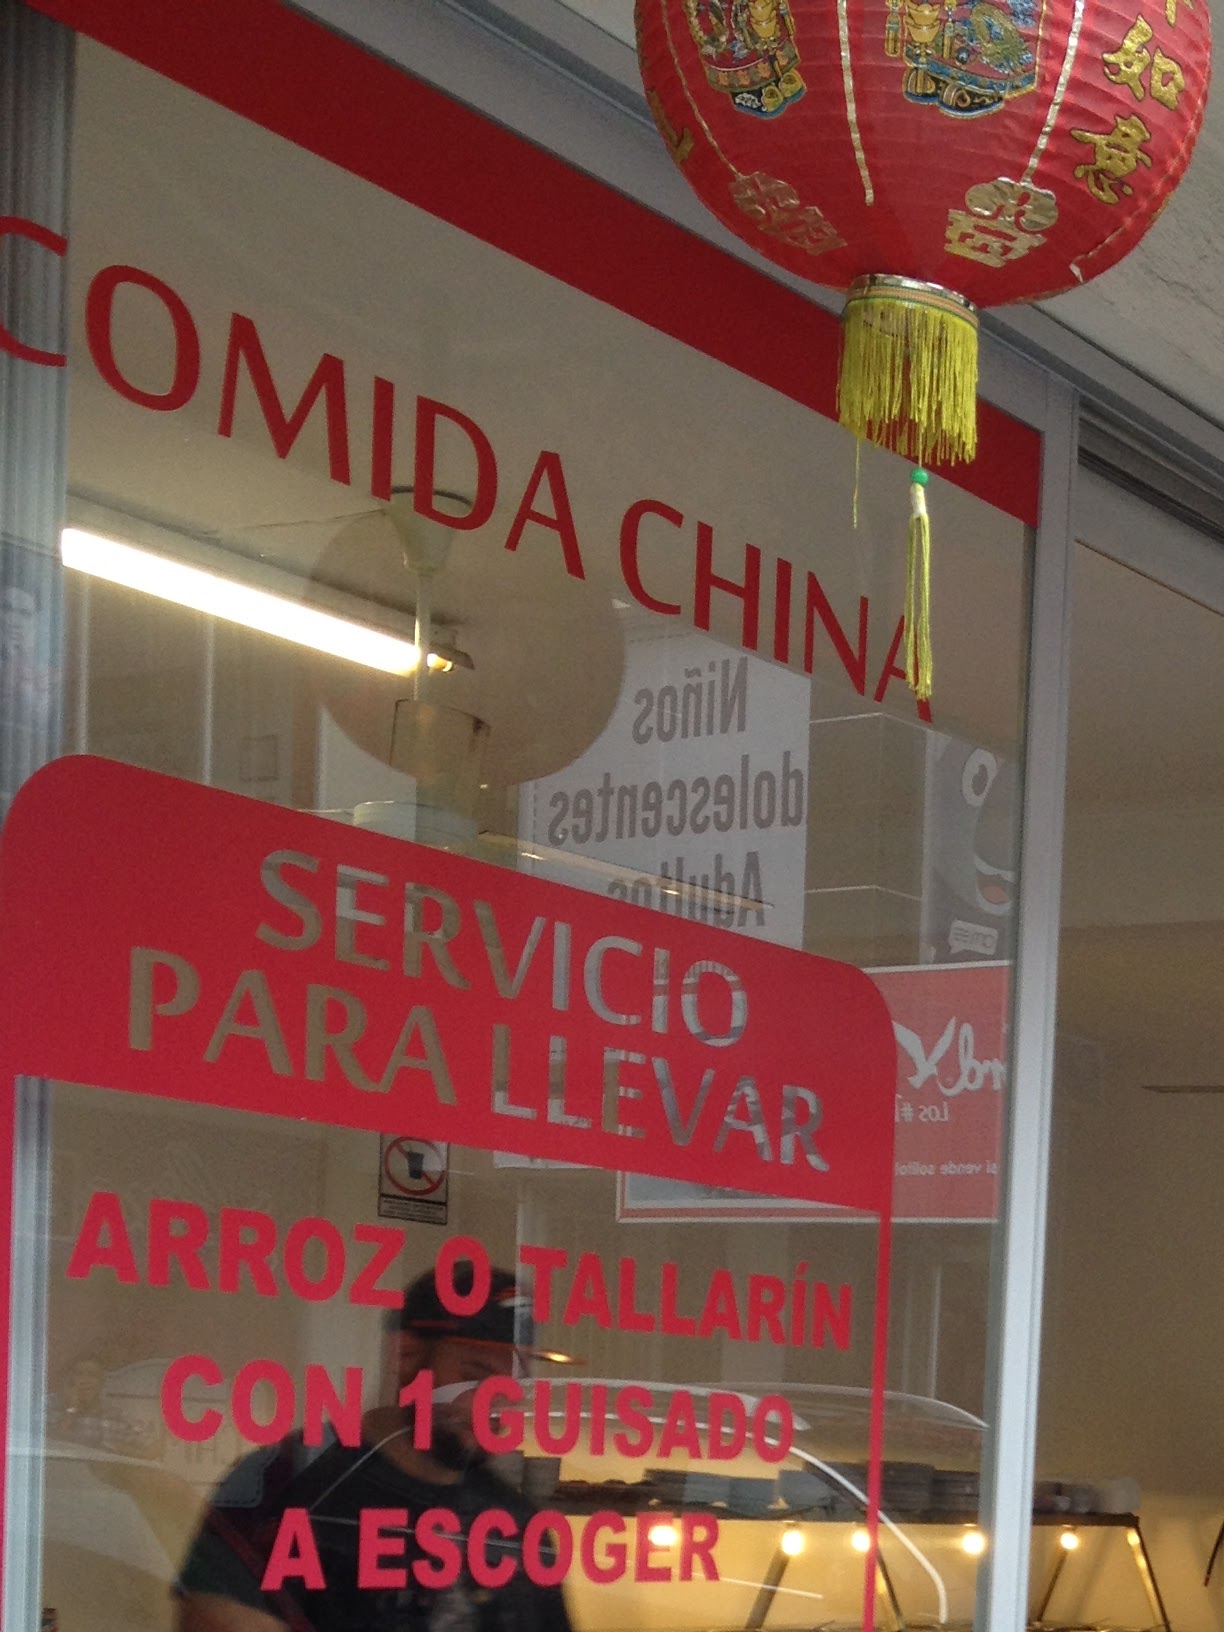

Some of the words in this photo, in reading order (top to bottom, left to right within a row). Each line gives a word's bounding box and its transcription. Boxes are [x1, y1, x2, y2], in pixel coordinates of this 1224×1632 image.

[256, 849, 749, 1047] SERVICIO
[127, 945, 457, 1106] PARA
[491, 1023, 830, 1172] LLEVAR
[65, 1191, 406, 1310] ARROZ
[434, 1236, 493, 1317] O
[519, 1244, 855, 1351] TALLARÍN
[160, 1353, 365, 1449] CON
[398, 1368, 435, 1451] 1
[472, 1375, 796, 1464] GUISADO
[261, 1508, 327, 1591] A
[357, 1508, 723, 1591] ESCOGER
